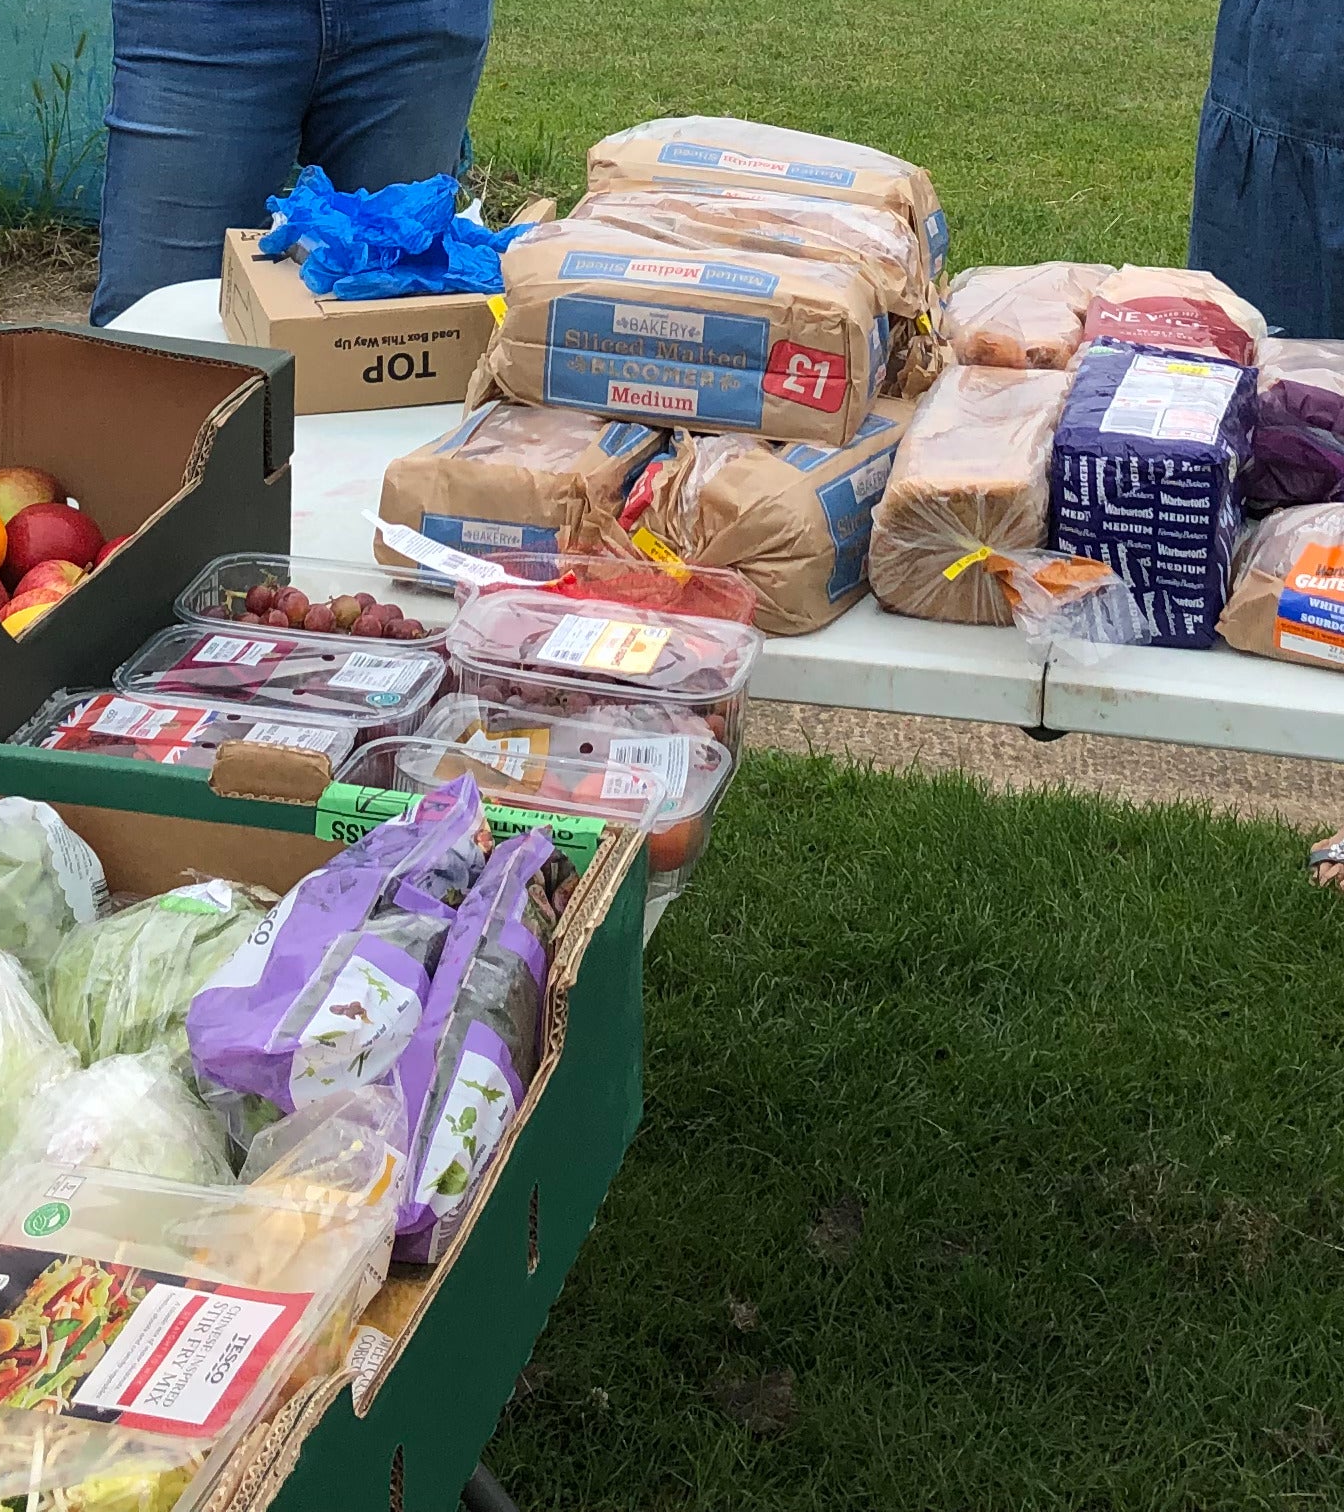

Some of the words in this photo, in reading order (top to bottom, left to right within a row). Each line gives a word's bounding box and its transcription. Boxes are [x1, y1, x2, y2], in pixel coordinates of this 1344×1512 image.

[672, 147, 719, 163] Sliced
[722, 153, 786, 173] Medium
[574, 259, 624, 275] Sliced
[630, 262, 701, 282] Medium
[705, 268, 765, 287] Malted
[408, 330, 429, 343] Box
[431, 329, 461, 341] Load
[629, 317, 688, 338] BAKERY
[334, 337, 352, 350] Up
[354, 336, 379, 348] Way
[381, 333, 407, 346] This
[564, 329, 644, 357] Sliced
[658, 344, 748, 369] Malted
[362, 350, 436, 384] TOP
[590, 359, 719, 389] BLOOMER
[782, 353, 831, 400] £1
[610, 385, 694, 412] Medium
[1079, 455, 1090, 505] MEDIUM
[1159, 490, 1210, 509] Warburtons
[1103, 500, 1154, 519] Warburtons
[1158, 511, 1209, 524] MEDIUM
[472, 530, 512, 544] BAKERY
[1102, 520, 1153, 535] MEDIUM
[1156, 541, 1207, 559] Warburtons
[1156, 560, 1206, 574] MEDIUM
[485, 805, 581, 824] LABELLIN
[253, 908, 278, 945] SCO
[193, 1301, 230, 1335] STIR
[200, 1305, 242, 1354] CHINESE
[171, 1338, 203, 1376] FRY
[210, 1333, 252, 1385] TESCO
[144, 1372, 177, 1407] MIX
[162, 1353, 206, 1409] INSPIRED
